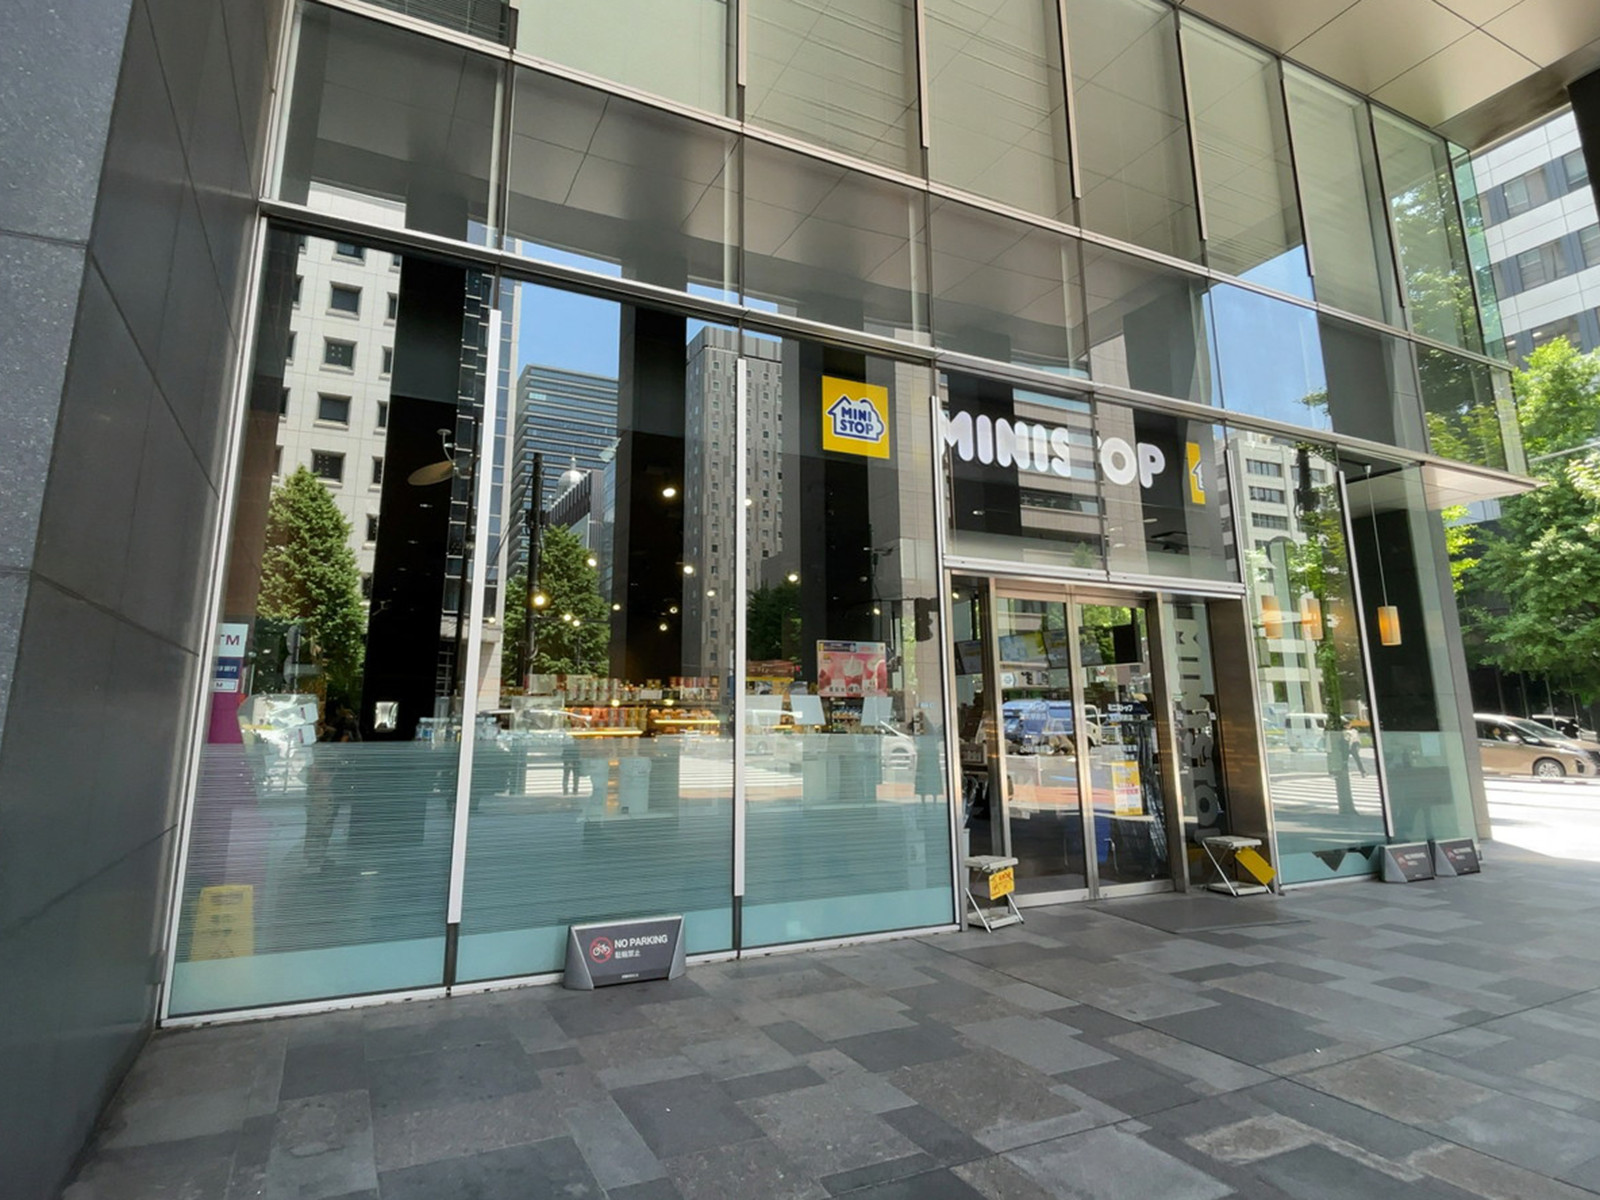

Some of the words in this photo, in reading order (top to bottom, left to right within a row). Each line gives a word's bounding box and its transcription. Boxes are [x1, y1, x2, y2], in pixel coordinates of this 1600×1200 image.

[841, 406, 872, 422] MINI
[840, 419, 874, 435] STOP
[938, 409, 1166, 489] MINISOP
[614, 938, 629, 948] NO
[629, 934, 668, 946] PARKING
